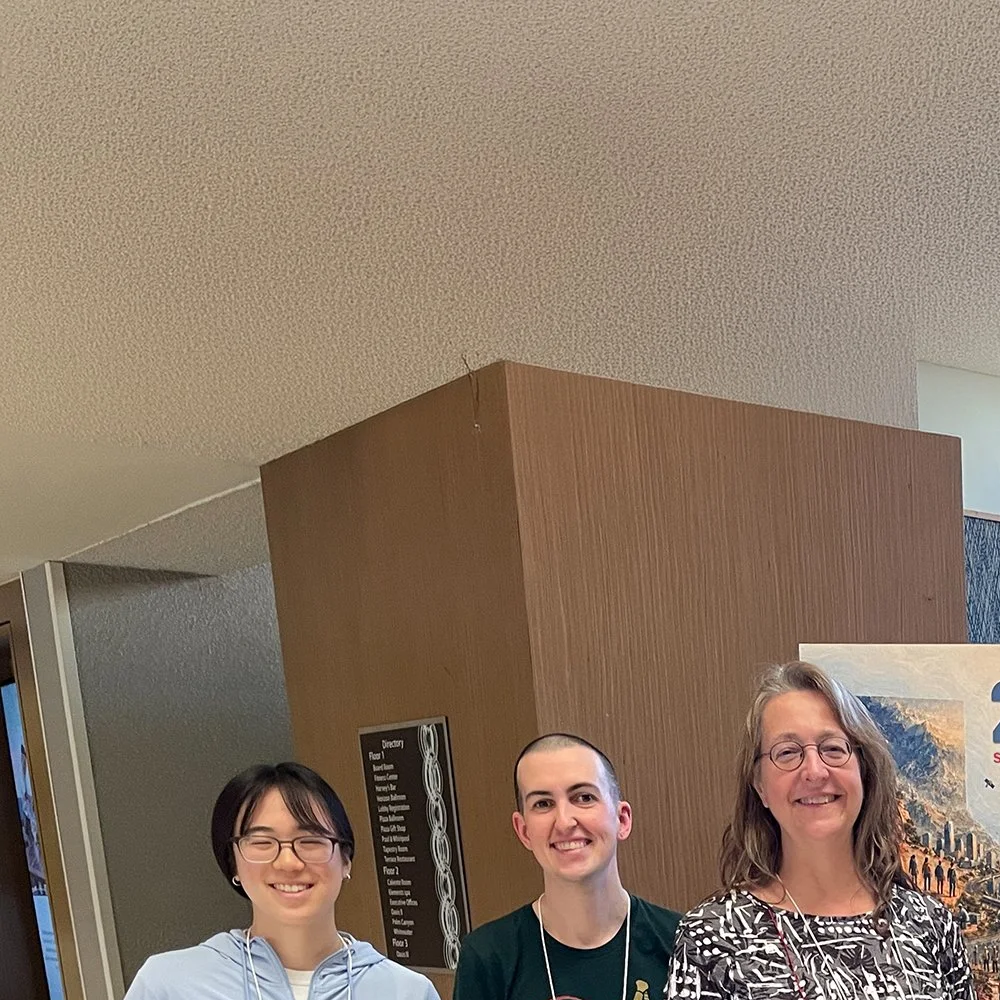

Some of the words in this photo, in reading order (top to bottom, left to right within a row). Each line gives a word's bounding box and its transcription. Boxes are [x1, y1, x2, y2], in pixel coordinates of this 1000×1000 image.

[382, 739, 404, 749] Directory
[369, 751, 381, 760] Floor
[383, 865, 395, 875] Floor
[393, 938, 404, 947] Floor
